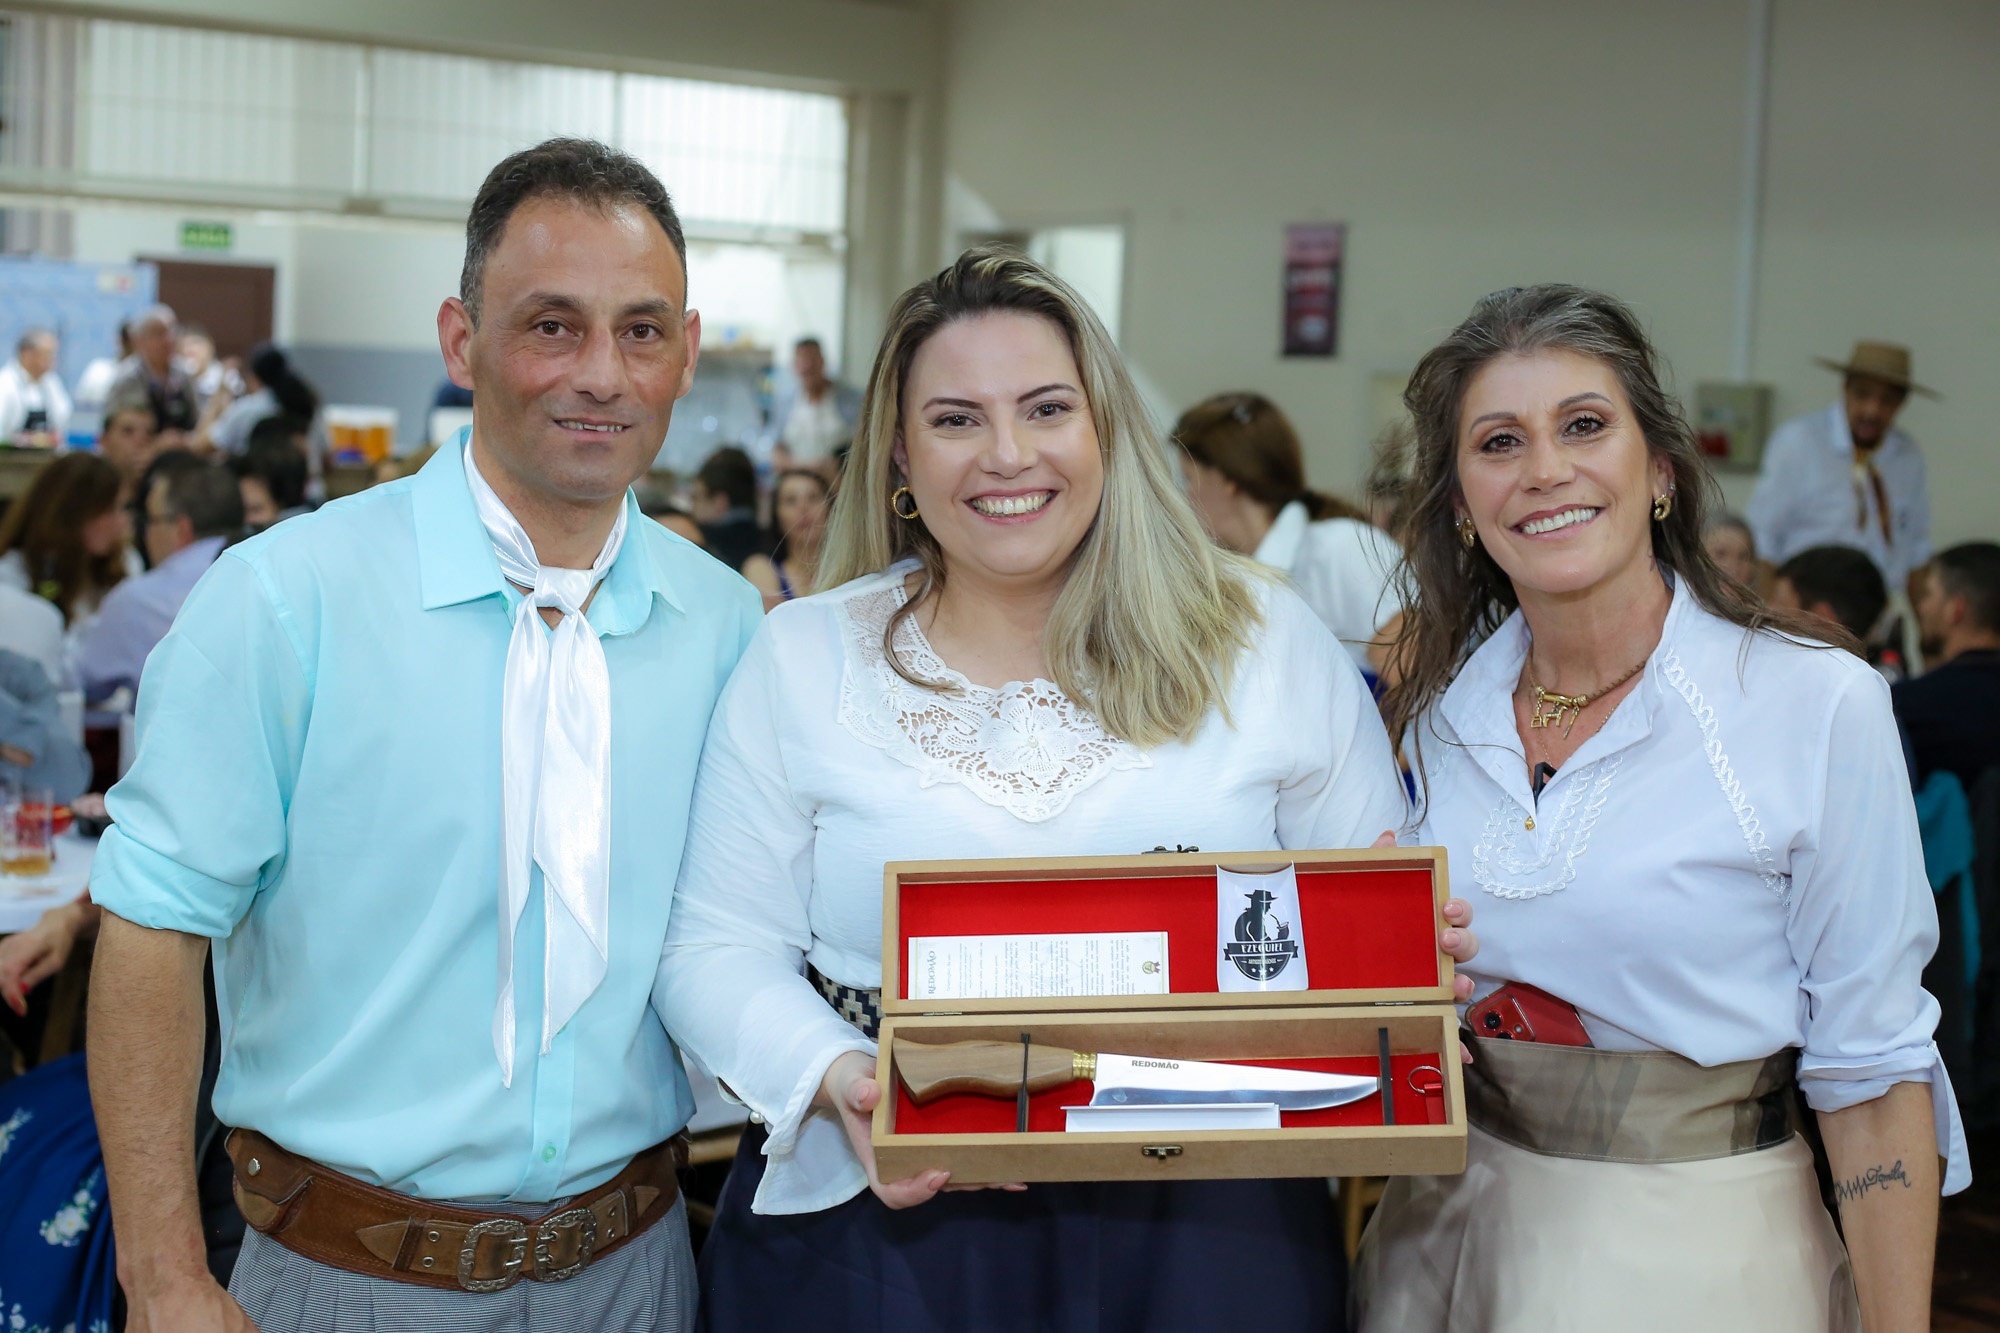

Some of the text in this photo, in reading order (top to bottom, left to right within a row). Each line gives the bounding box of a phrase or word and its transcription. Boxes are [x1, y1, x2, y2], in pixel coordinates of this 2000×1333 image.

[1241, 943, 1283, 953] EZEQUIEL
[927, 950, 936, 994] REDOMÃO
[1131, 1060, 1180, 1070] REDOMÃO
